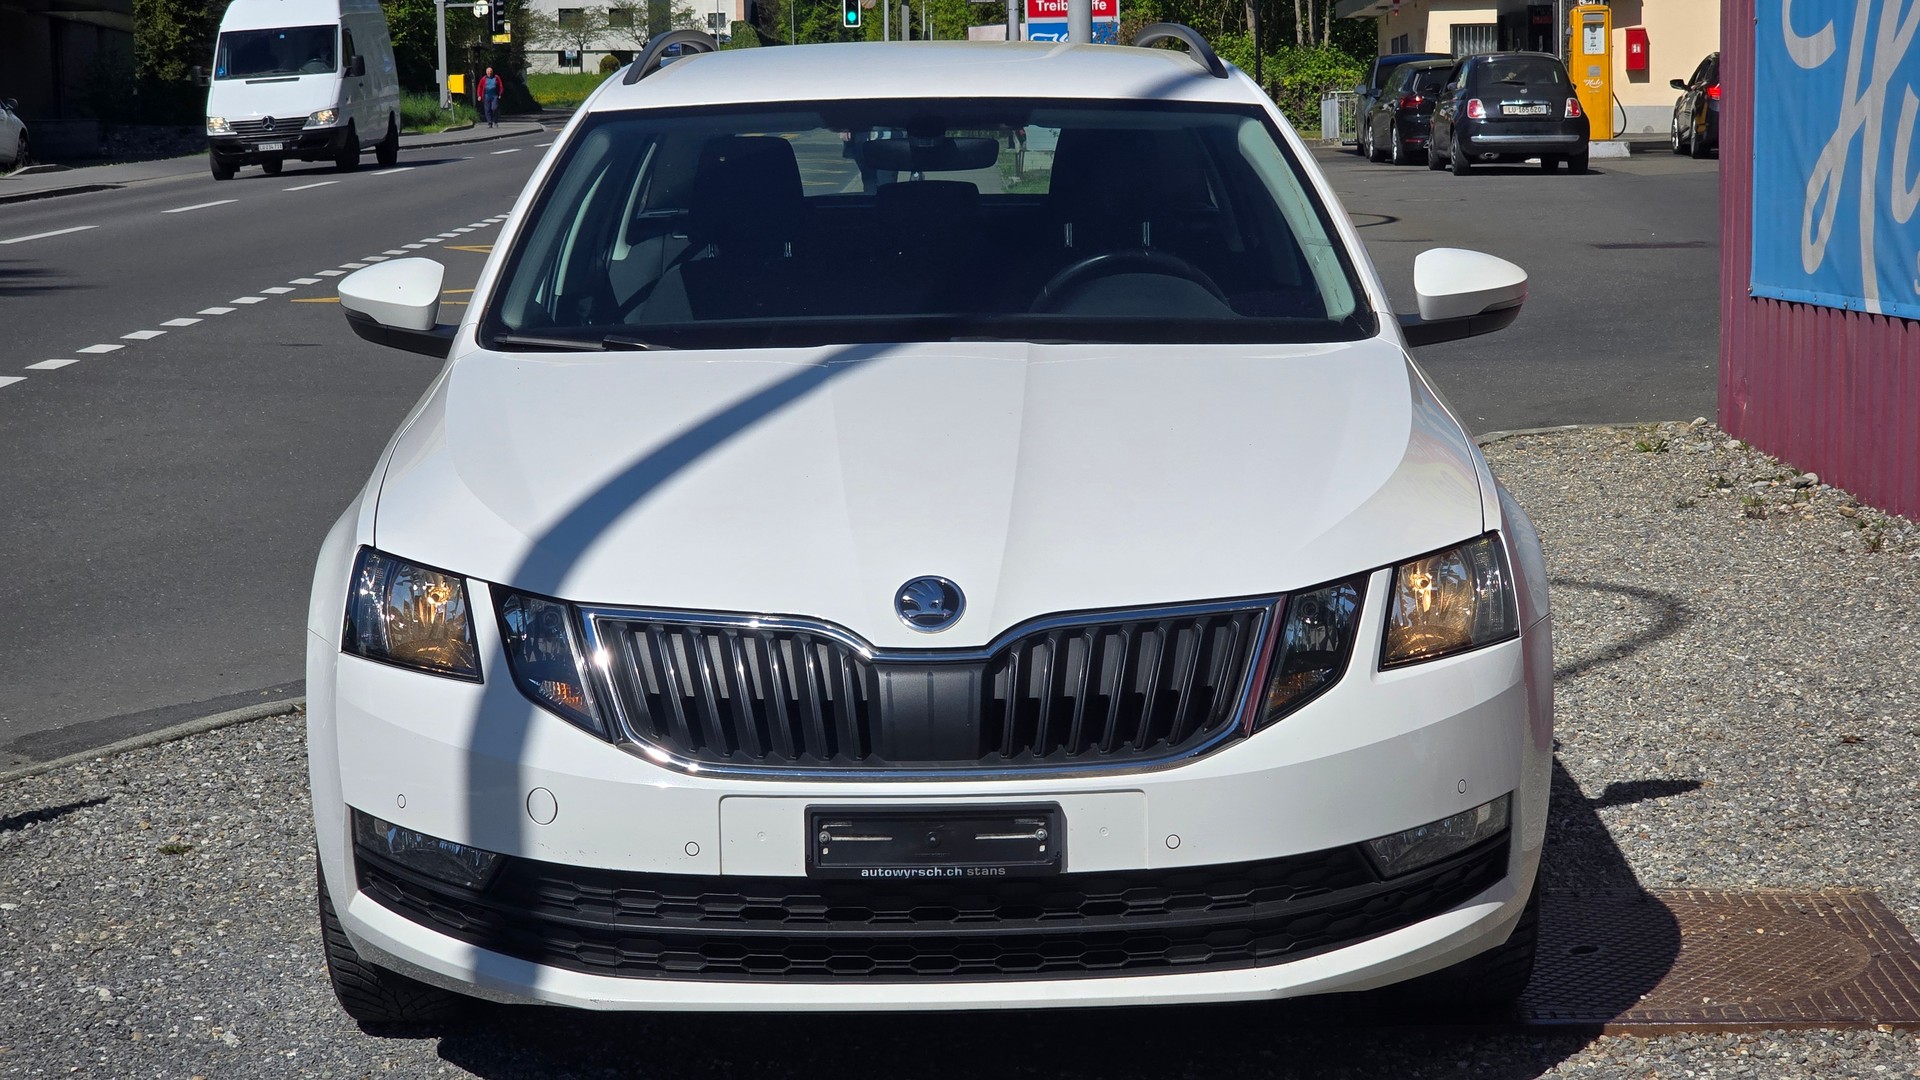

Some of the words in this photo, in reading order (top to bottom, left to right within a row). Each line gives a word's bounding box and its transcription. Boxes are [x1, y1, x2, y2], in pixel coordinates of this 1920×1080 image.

[1036, 0, 1107, 11] Treibffe
[861, 866, 963, 879] autowyrsch.ch
[966, 866, 1006, 876] stans
